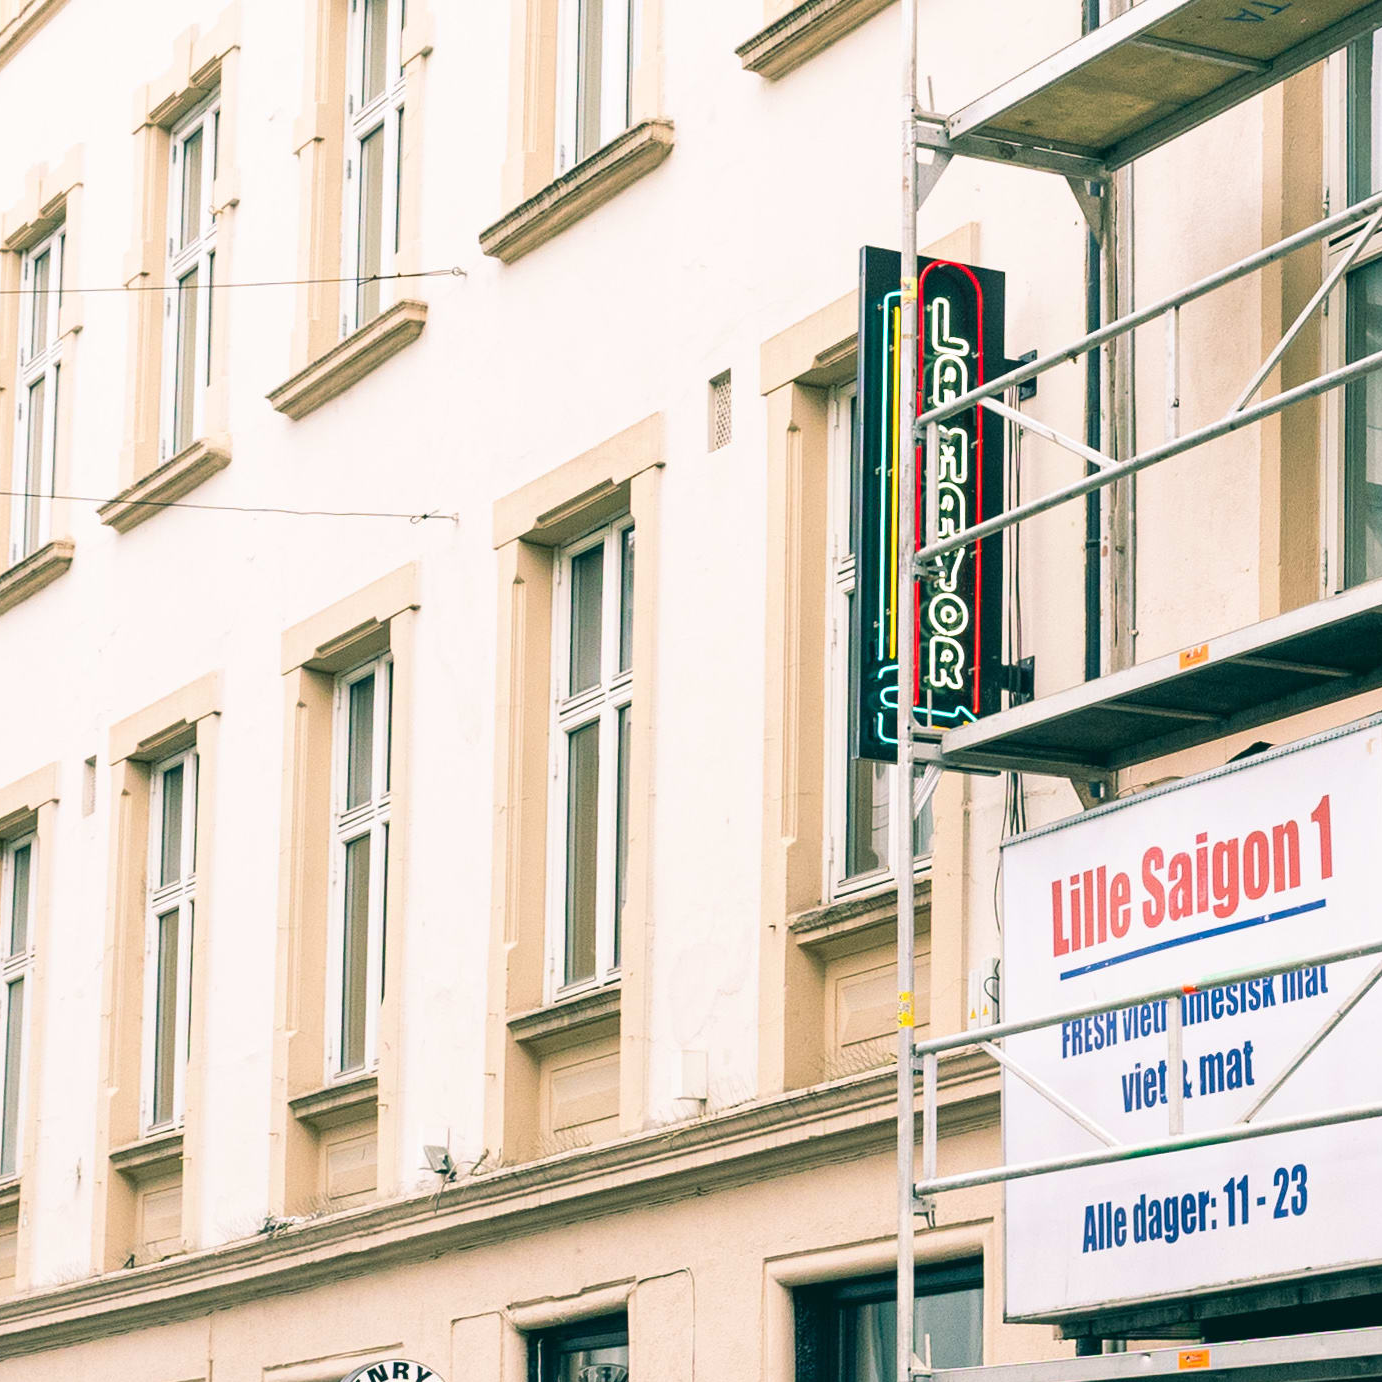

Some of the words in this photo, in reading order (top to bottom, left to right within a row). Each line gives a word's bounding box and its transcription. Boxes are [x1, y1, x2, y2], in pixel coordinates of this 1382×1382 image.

[1051, 863, 1132, 958] Lille
[1141, 816, 1302, 929] Saigon
[1311, 794, 1334, 880] 1
[1061, 1011, 1118, 1059] FRESH
[1121, 975, 1277, 1042] vietmesisk
[1122, 1060, 1169, 1113] viet
[1199, 1040, 1255, 1096] mat
[1082, 1202, 1128, 1253] Alle
[1133, 1189, 1217, 1245] dager:
[1223, 1175, 1250, 1229] 11
[1257, 1196, 1266, 1205] -
[1272, 1163, 1308, 1218] 23
